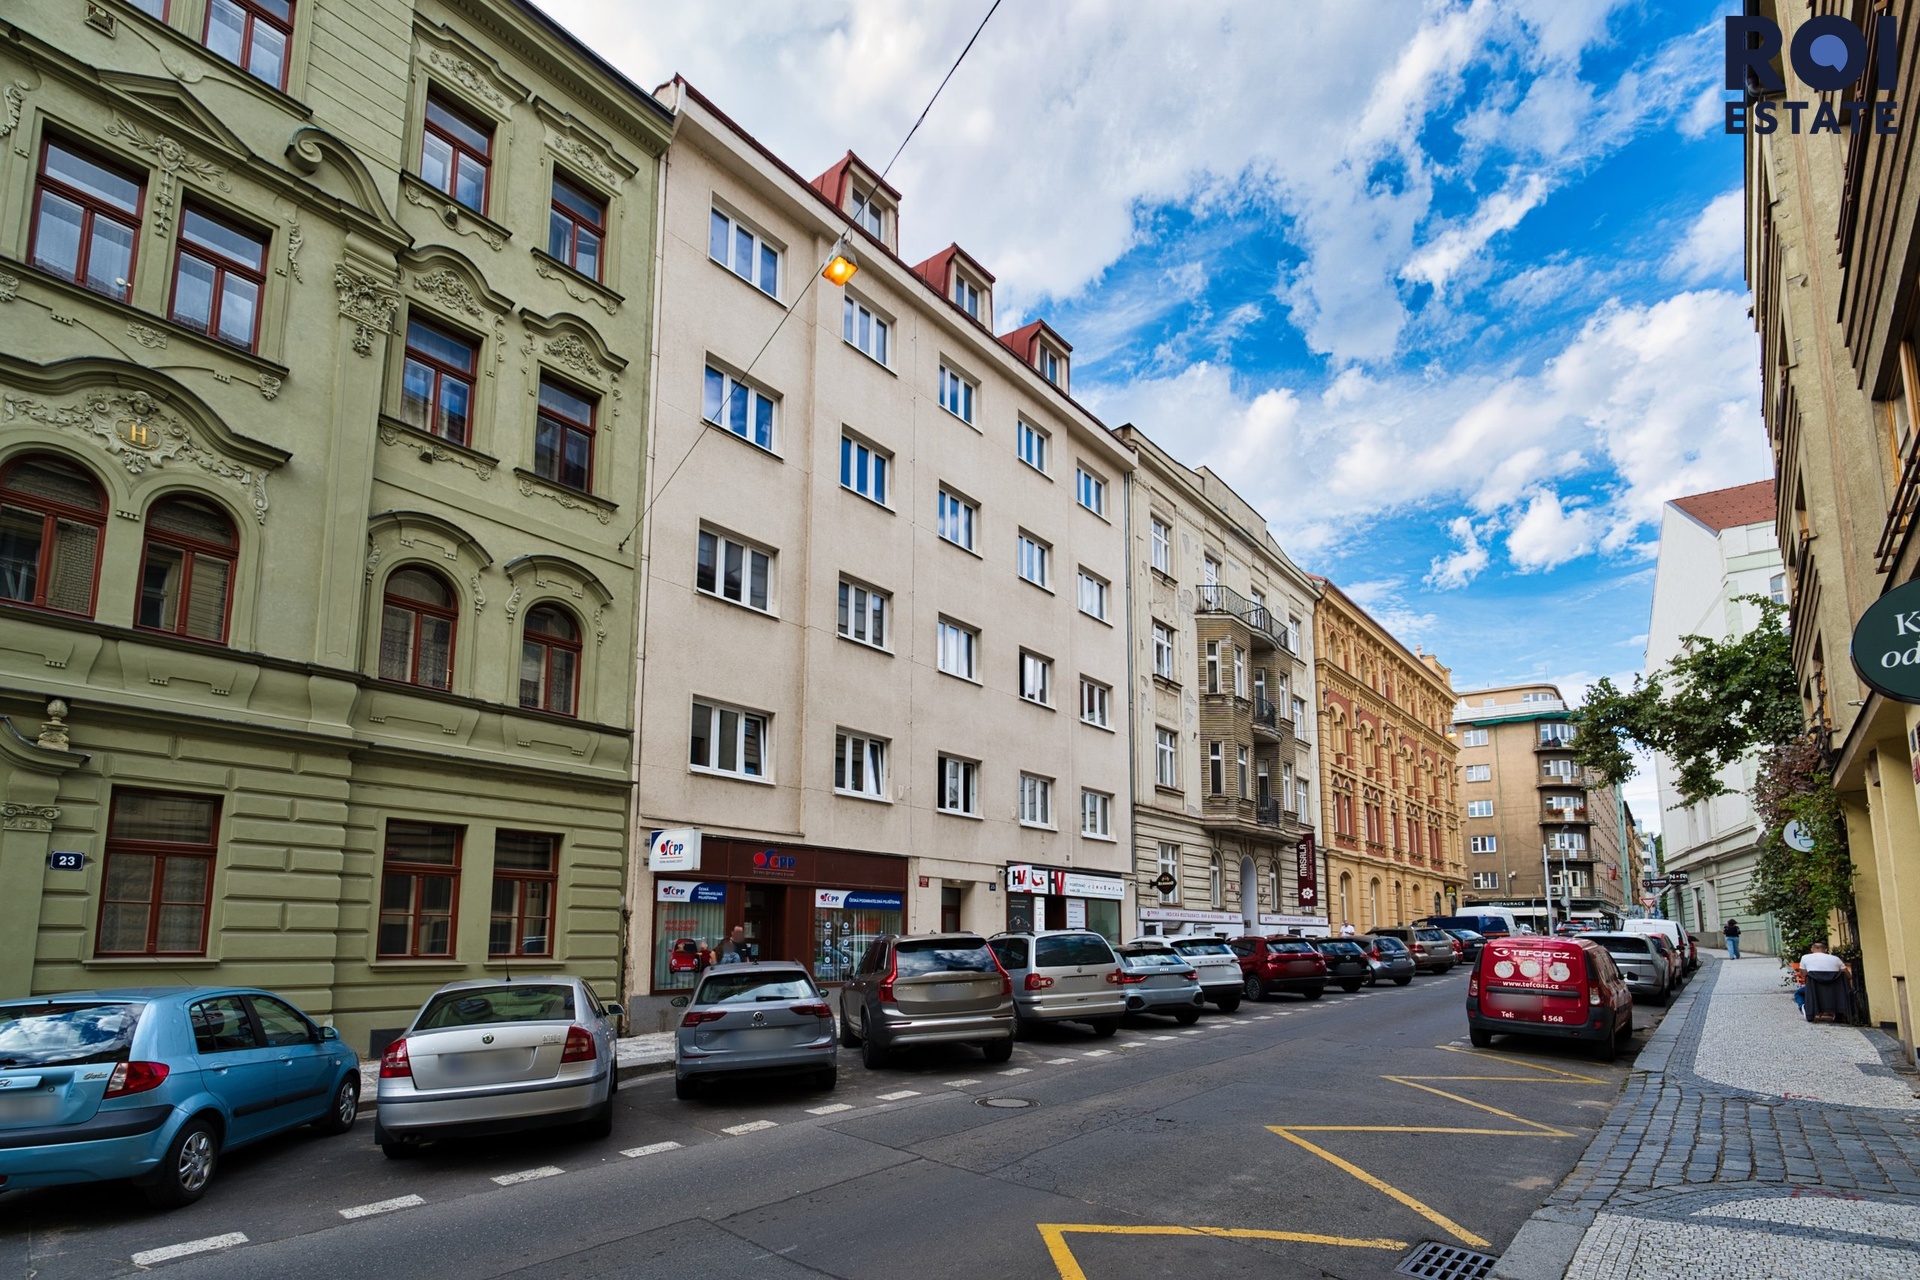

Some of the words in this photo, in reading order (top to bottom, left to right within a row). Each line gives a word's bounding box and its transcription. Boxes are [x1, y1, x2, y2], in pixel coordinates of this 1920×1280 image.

[131, 423, 147, 445] H
[1894, 611, 1920, 636] K
[668, 841, 684, 855] ČPP
[59, 856, 75, 866] 23
[1299, 844, 1307, 876] MASALA
[1012, 870, 1026, 885] HV
[1511, 949, 1551, 957] TEFCO
